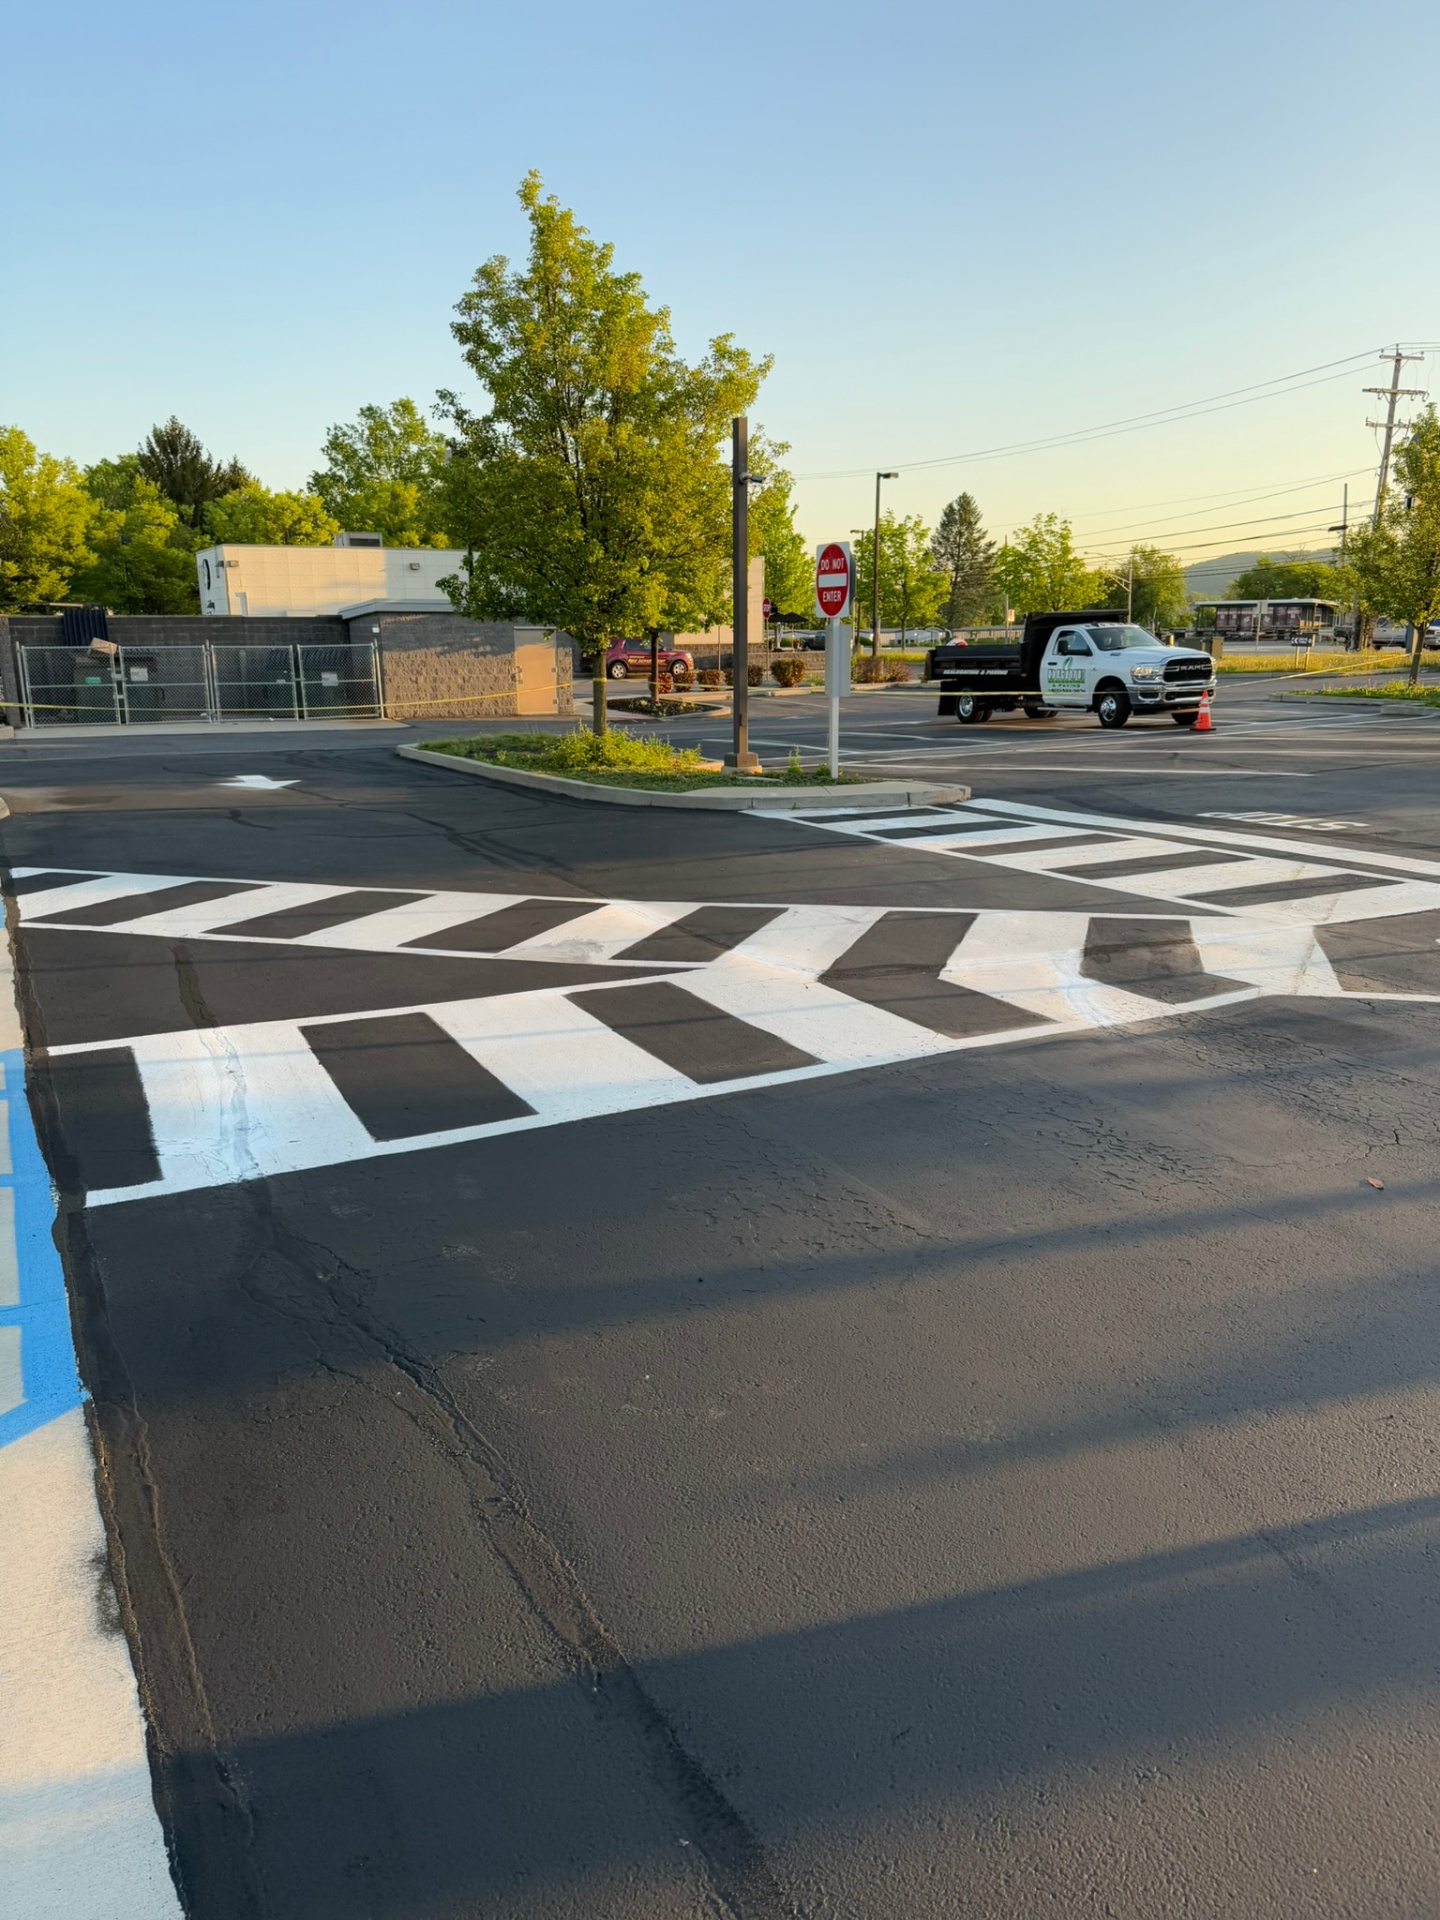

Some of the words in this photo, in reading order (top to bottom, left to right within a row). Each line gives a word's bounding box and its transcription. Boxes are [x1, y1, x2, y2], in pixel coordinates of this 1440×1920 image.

[821, 559, 830, 571] DO
[832, 558, 845, 570] NOT
[823, 591, 842, 602] ENTER
